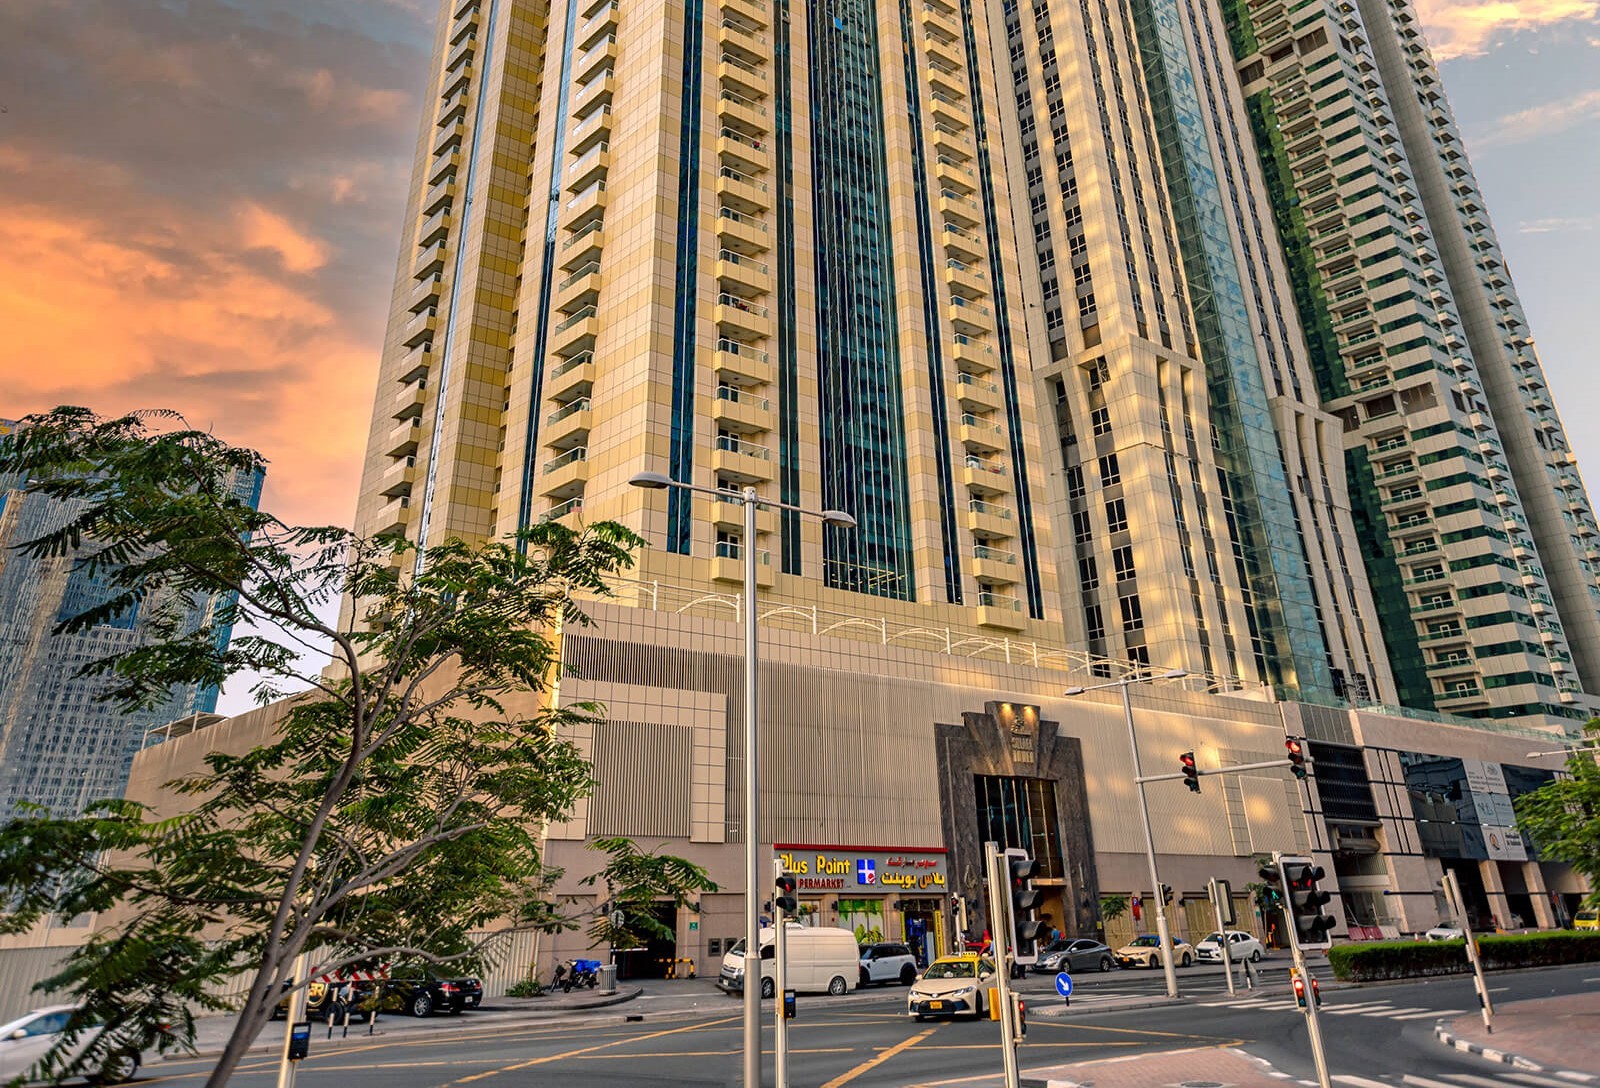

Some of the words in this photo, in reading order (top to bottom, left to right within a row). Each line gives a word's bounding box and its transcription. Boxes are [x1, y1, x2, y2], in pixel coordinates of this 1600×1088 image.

[816, 855, 851, 874] Point
[797, 878, 845, 889] PERMARKET
[881, 871, 917, 889] بوينت
[919, 872, 945, 889] بلاس
